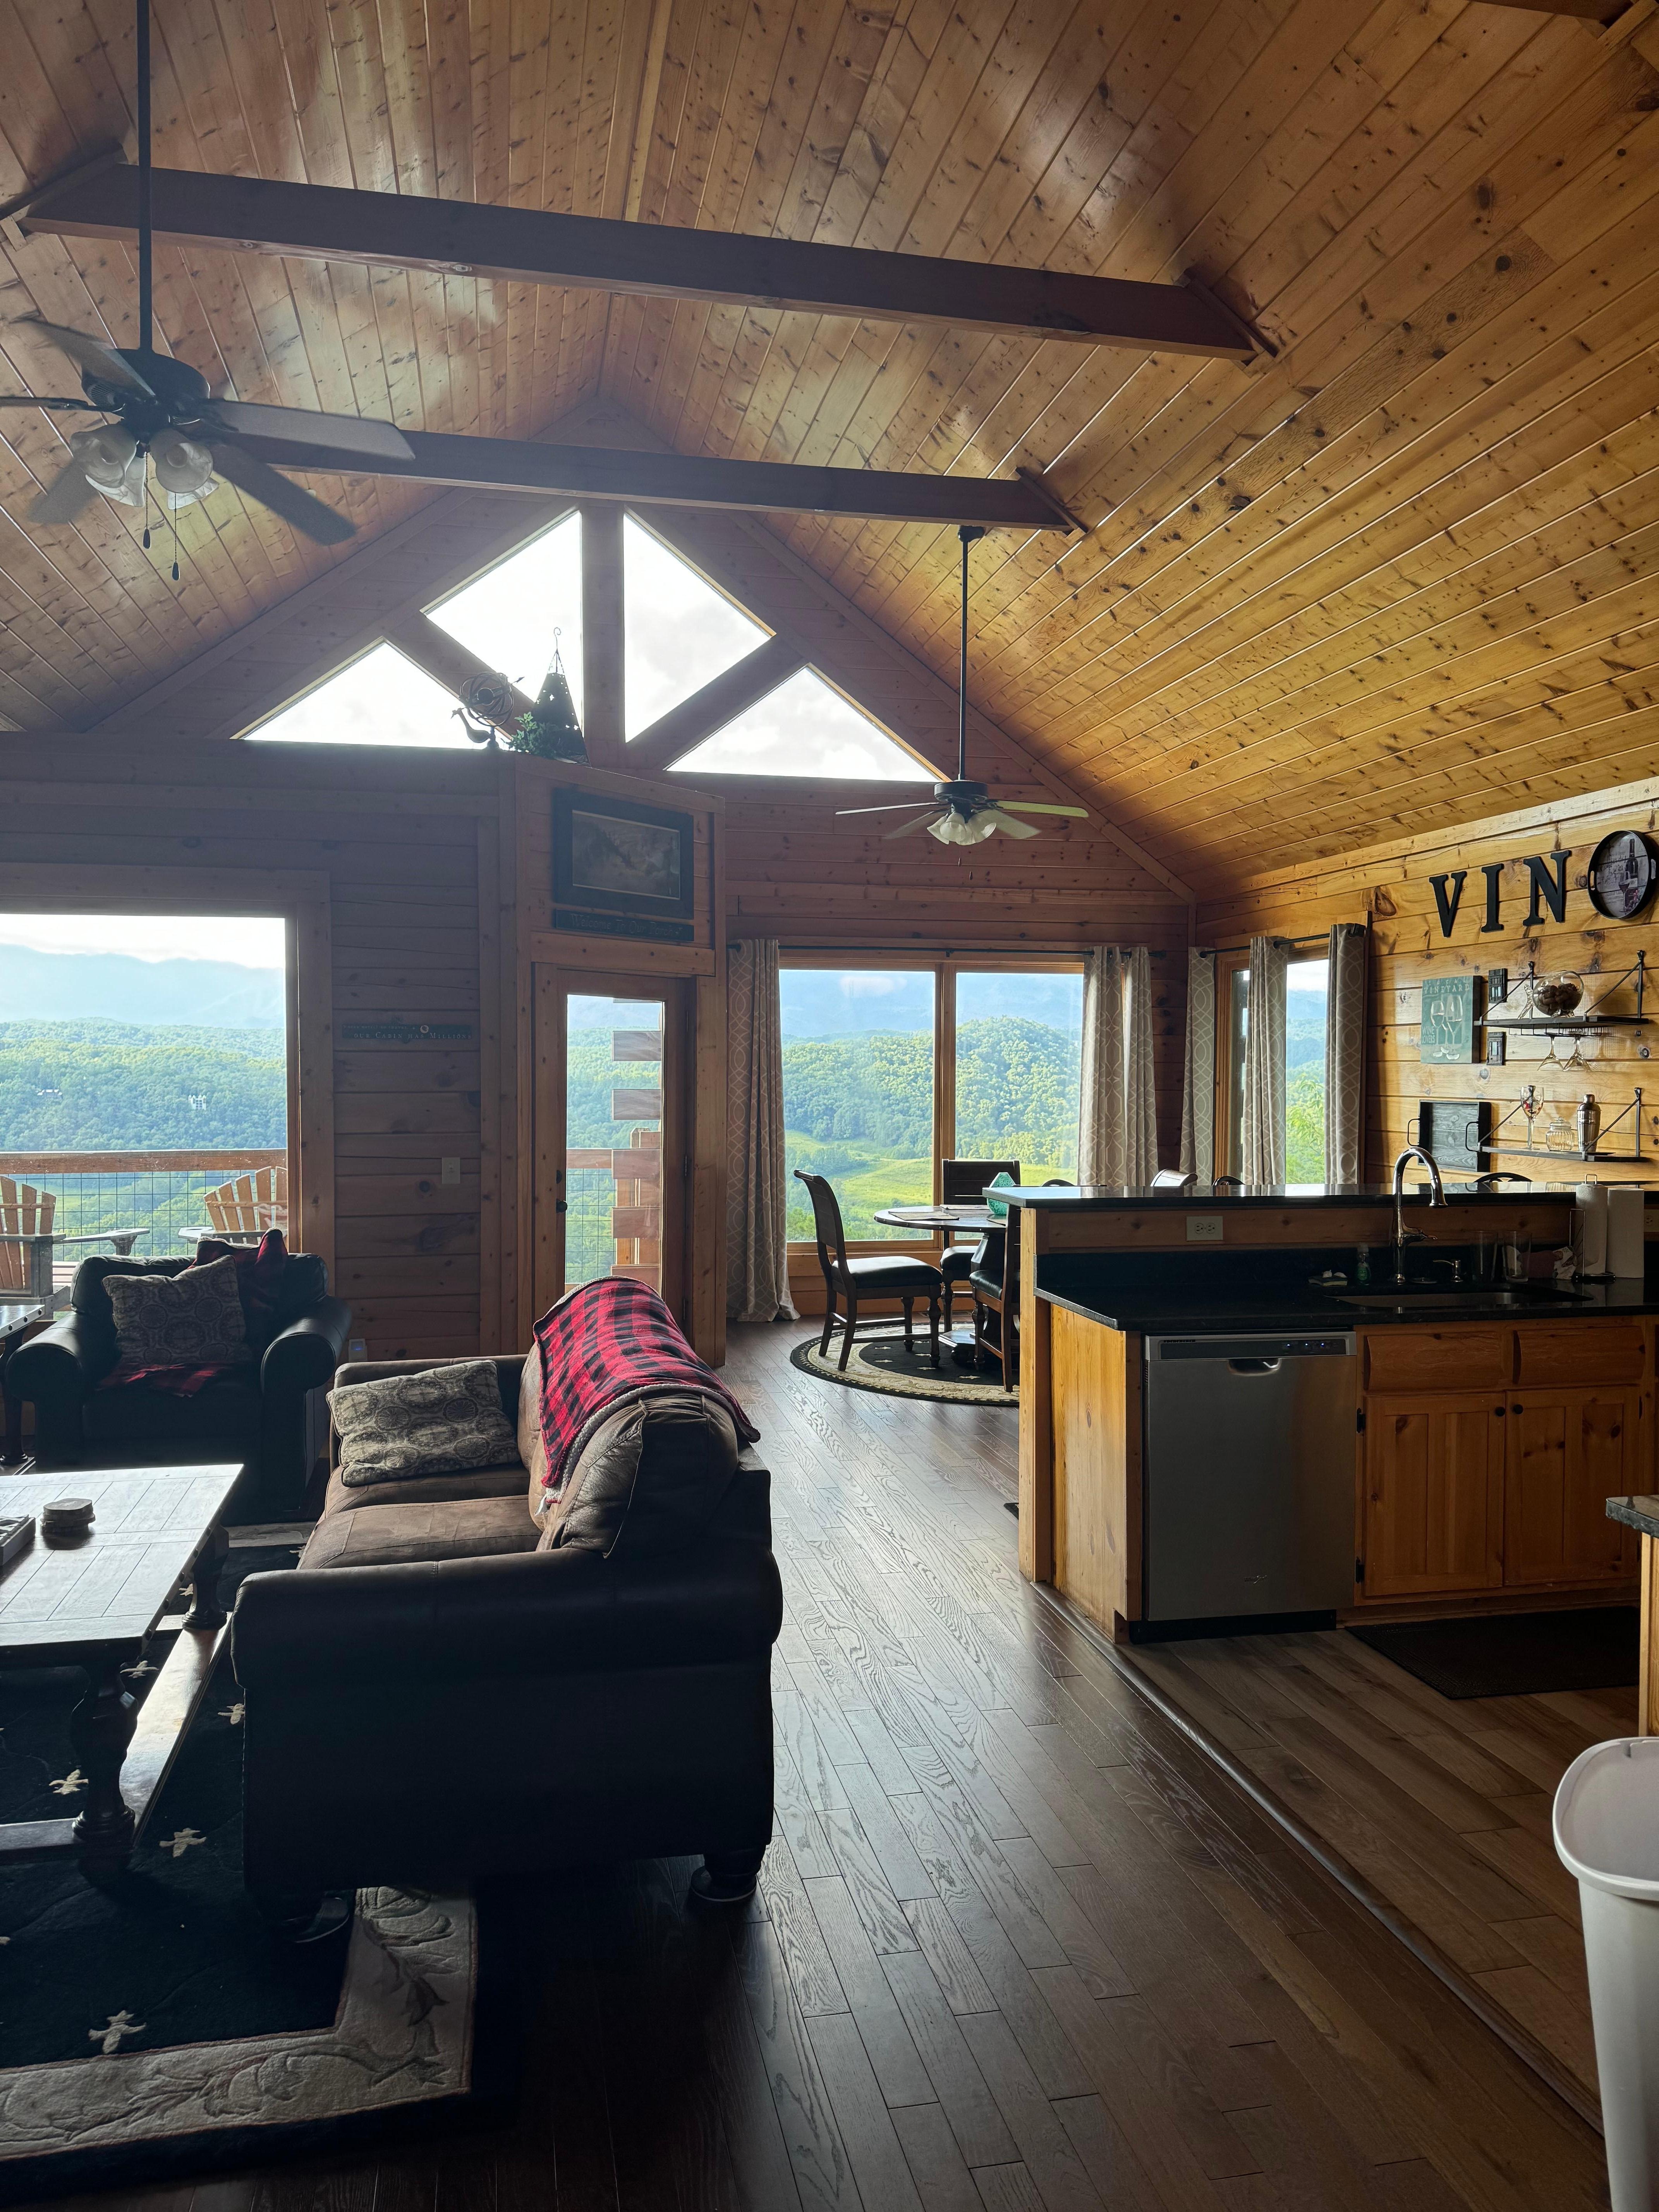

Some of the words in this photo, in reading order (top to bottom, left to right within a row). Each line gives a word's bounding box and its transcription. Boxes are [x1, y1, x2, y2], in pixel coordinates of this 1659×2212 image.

[570, 914, 613, 929] Welcome
[615, 919, 626, 932] To
[629, 921, 646, 934] Our
[648, 921, 673, 937] Porch
[1424, 984, 1470, 994] VINEYARD
[1422, 1025, 1435, 1035] WINE
[1421, 1035, 1436, 1044] LOVERS
